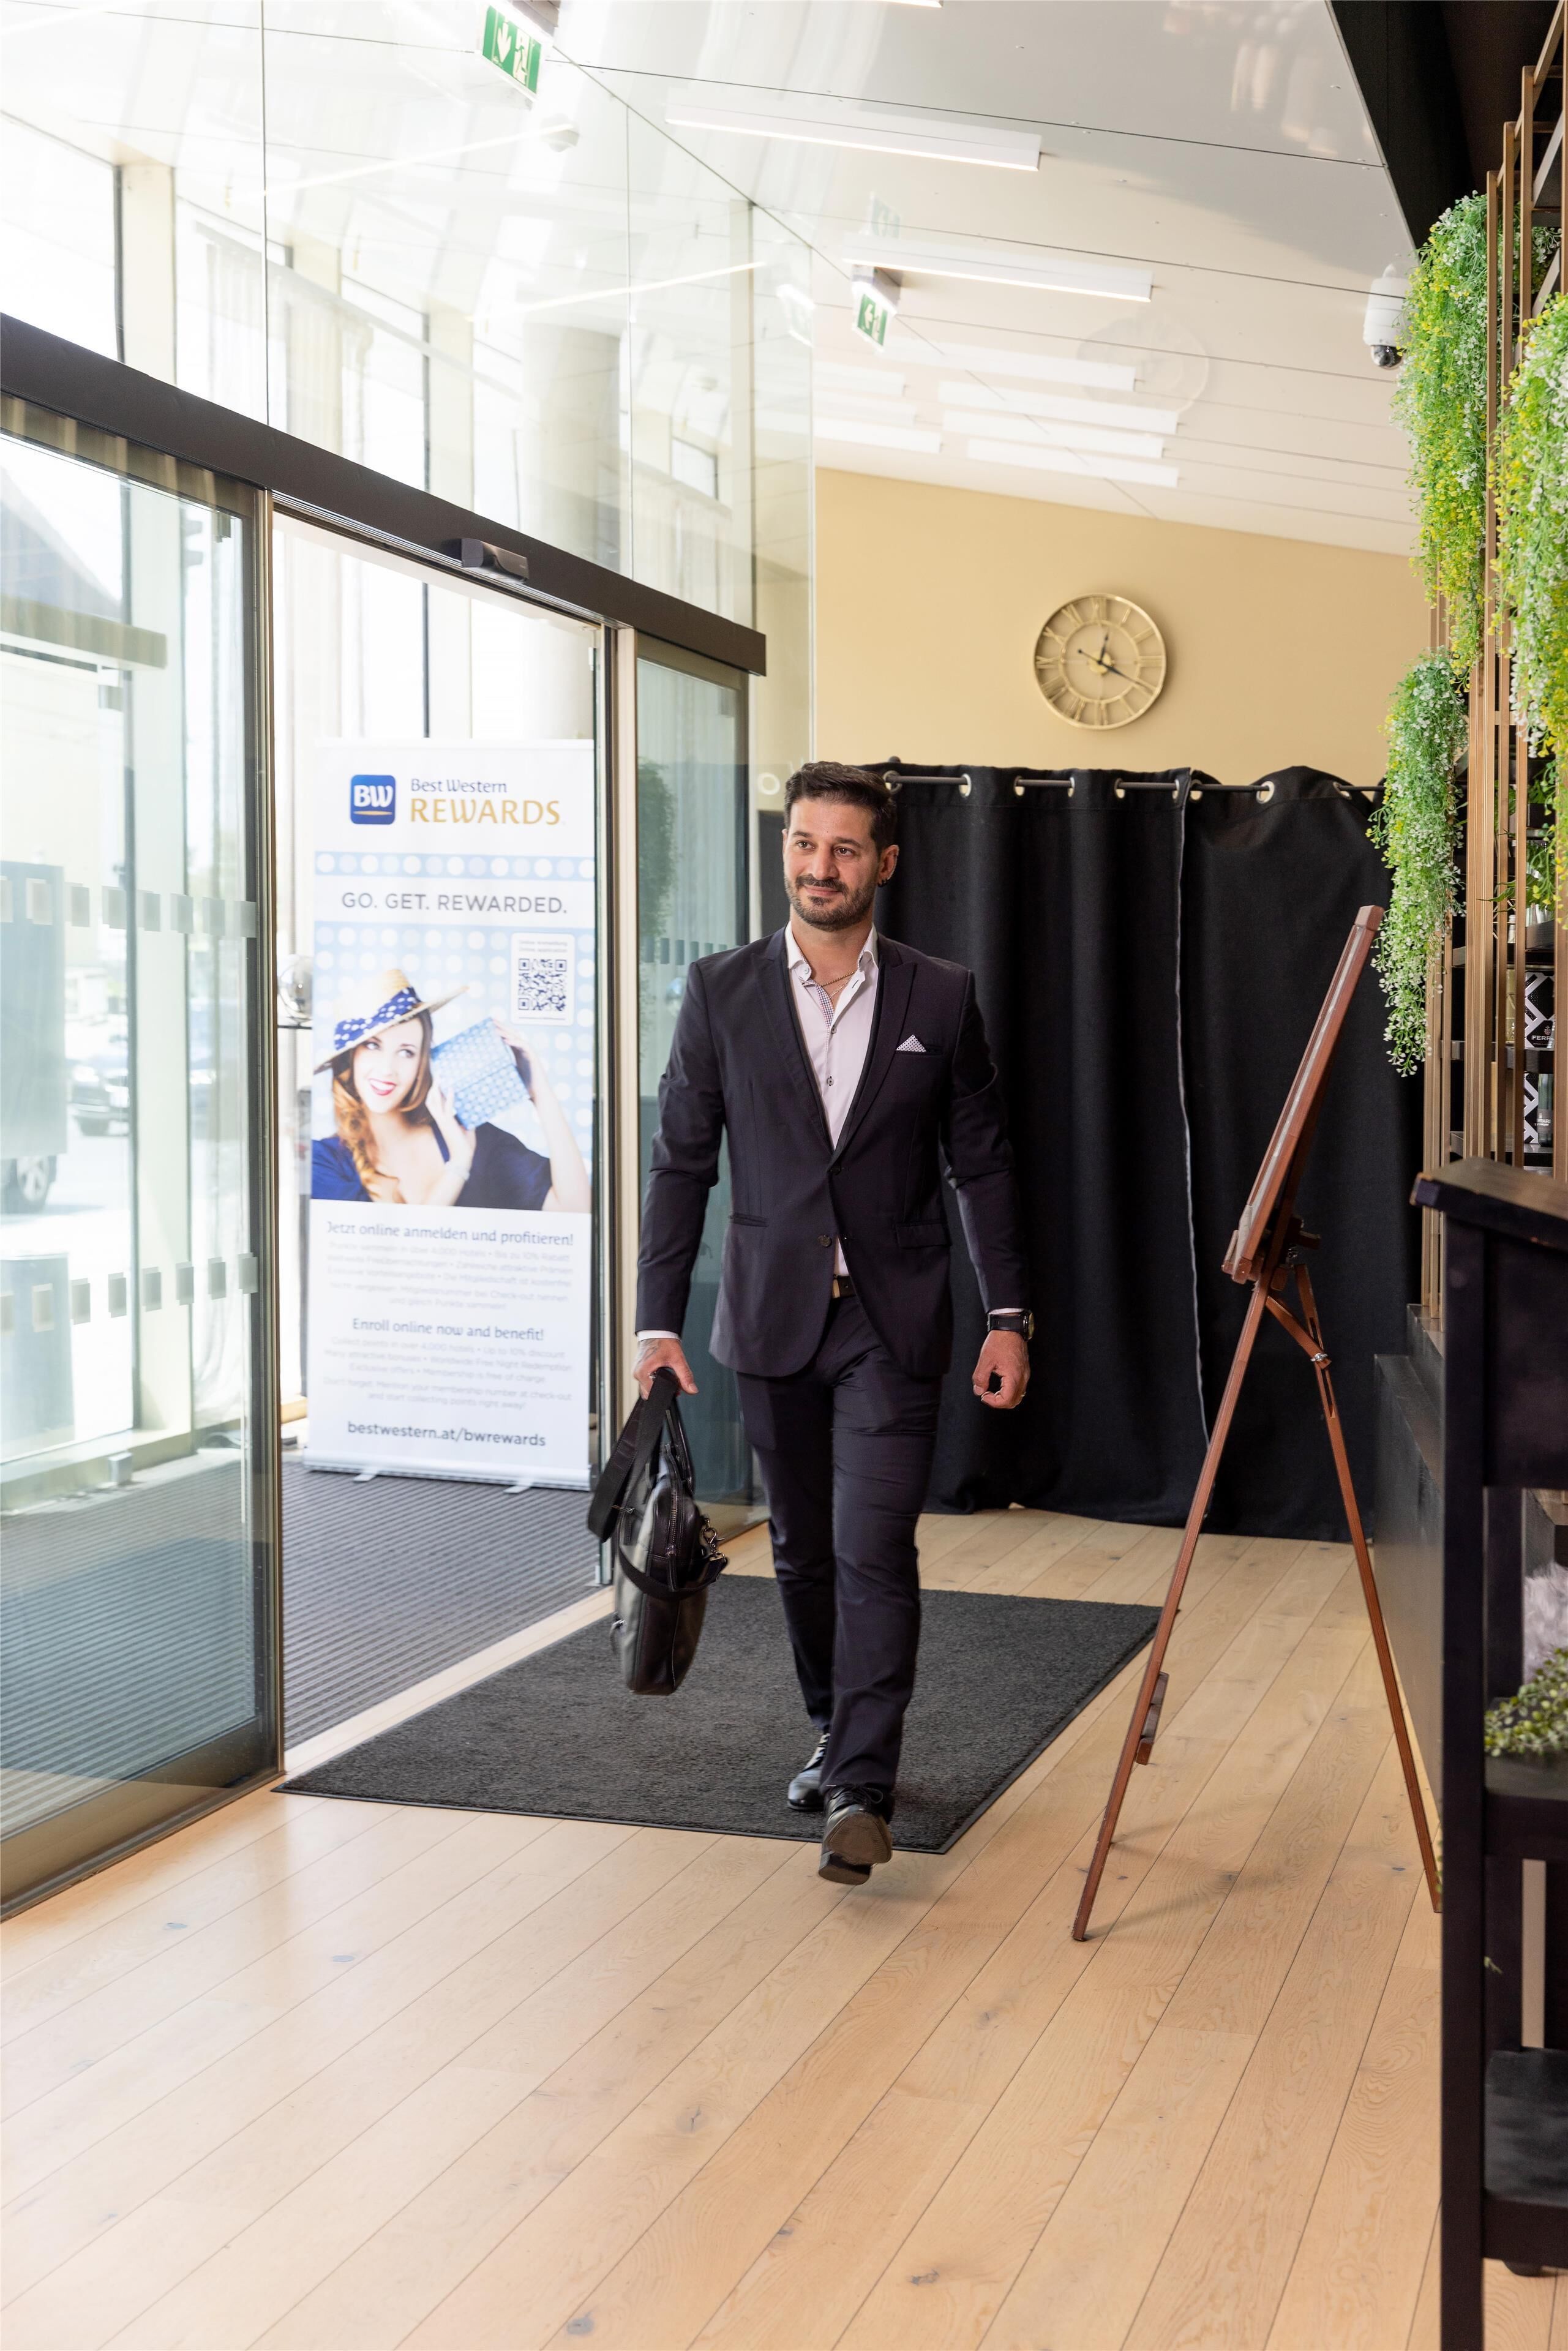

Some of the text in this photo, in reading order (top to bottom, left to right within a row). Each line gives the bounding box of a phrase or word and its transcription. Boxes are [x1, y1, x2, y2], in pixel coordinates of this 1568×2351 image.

[353, 785, 394, 808] BW
[411, 778, 508, 793] Best Western
[411, 798, 561, 826] REWARDS
[342, 892, 568, 913] GO. GET. REWARDED.
[327, 1221, 574, 1246] Jetzt online anmelden und profitieren!
[353, 1318, 544, 1341] Enroll online now and benefit!
[348, 1421, 546, 1447] bestwestern.at/bwrewards
